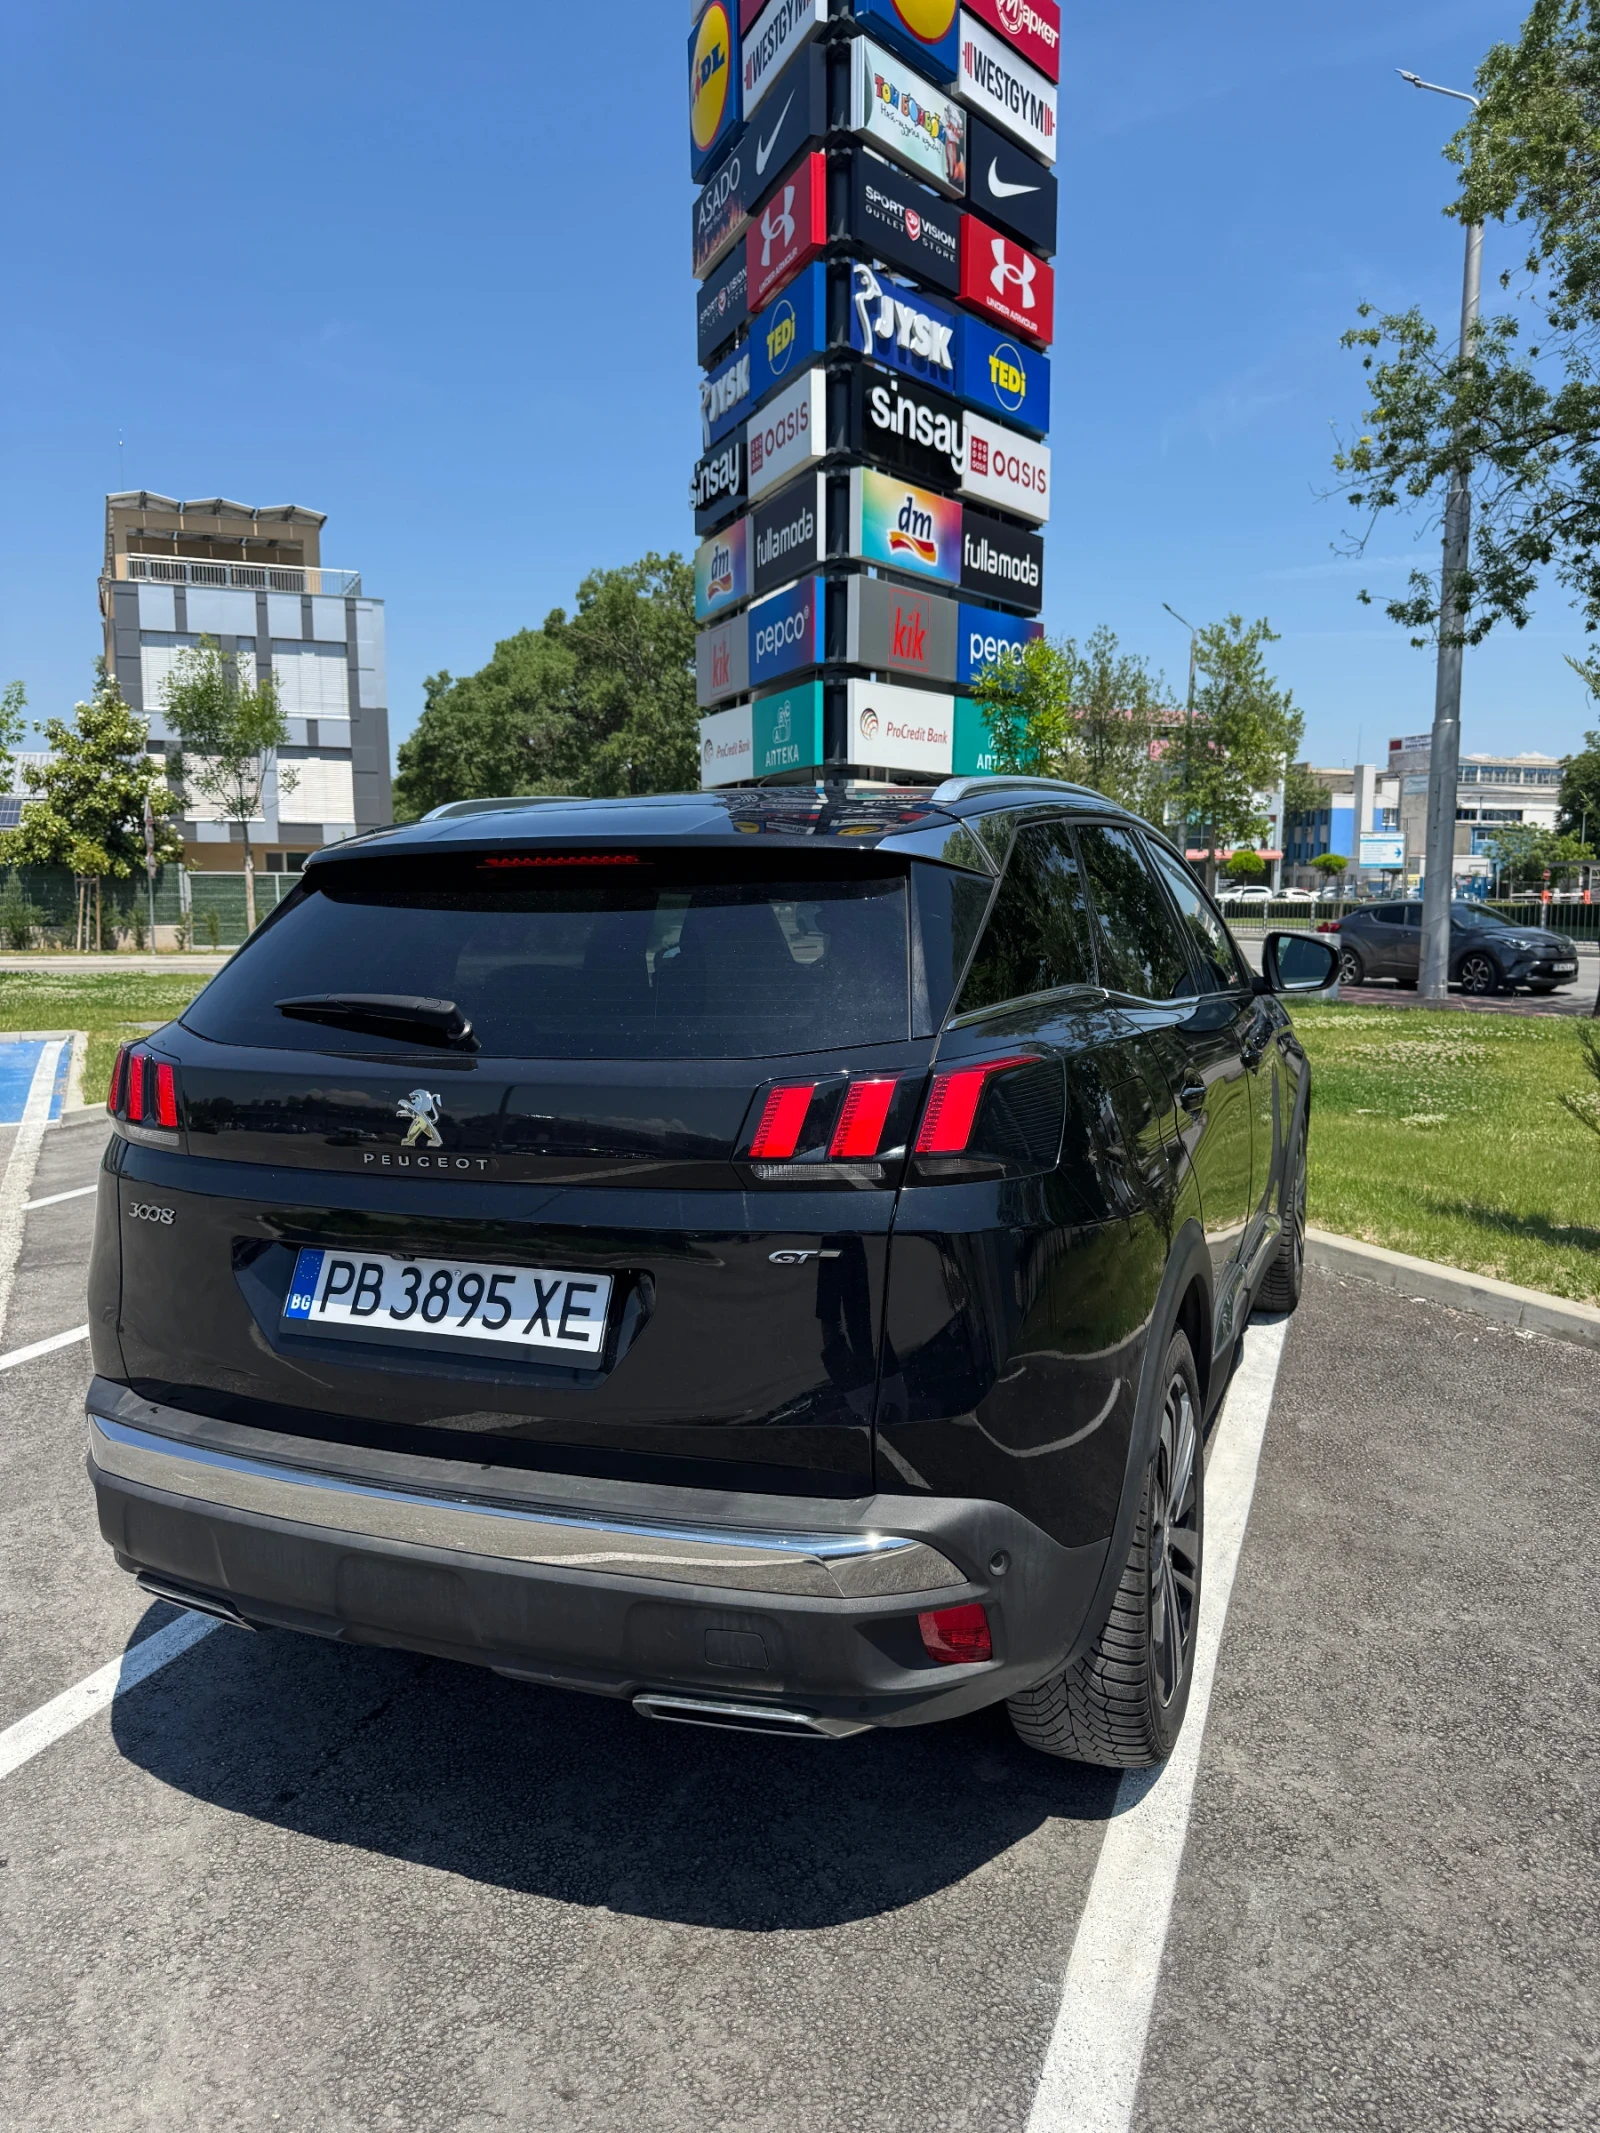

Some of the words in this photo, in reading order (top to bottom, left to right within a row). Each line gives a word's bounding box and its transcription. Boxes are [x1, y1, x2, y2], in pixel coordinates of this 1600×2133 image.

[973, 46, 1044, 133] WESTGYM
[698, 158, 740, 234] ASADO
[865, 185, 905, 217] SPORT
[921, 218, 956, 249] VISION
[865, 204, 905, 232] OUTLET
[922, 237, 956, 263] STORE
[766, 311, 795, 362] TEDi
[874, 295, 953, 370] JYSK
[986, 295, 1010, 317] UNDER
[1009, 310, 1038, 333] ARMOUR
[708, 353, 750, 422] JYSK
[988, 355, 1026, 398] TEDi
[765, 402, 809, 457] oasis
[870, 379, 968, 475] sinsay
[688, 442, 739, 510] sinsay
[993, 450, 1047, 494] oasis
[756, 507, 814, 568] fullamoda
[898, 497, 932, 540] dm
[711, 543, 729, 580] dm
[964, 533, 1039, 587] fullamoda
[970, 633, 1026, 665] pepc
[765, 744, 800, 768] АПТЕКА
[886, 721, 926, 742] ProCredit
[927, 727, 948, 745] Bank
[363, 1152, 488, 1171] PEUGEOT
[128, 1202, 175, 1225] 3008
[768, 1250, 819, 1264] GT
[290, 1293, 311, 1310] BG
[319, 1260, 384, 1316] PB
[389, 1266, 517, 1330] 3895
[522, 1278, 598, 1342] XE
